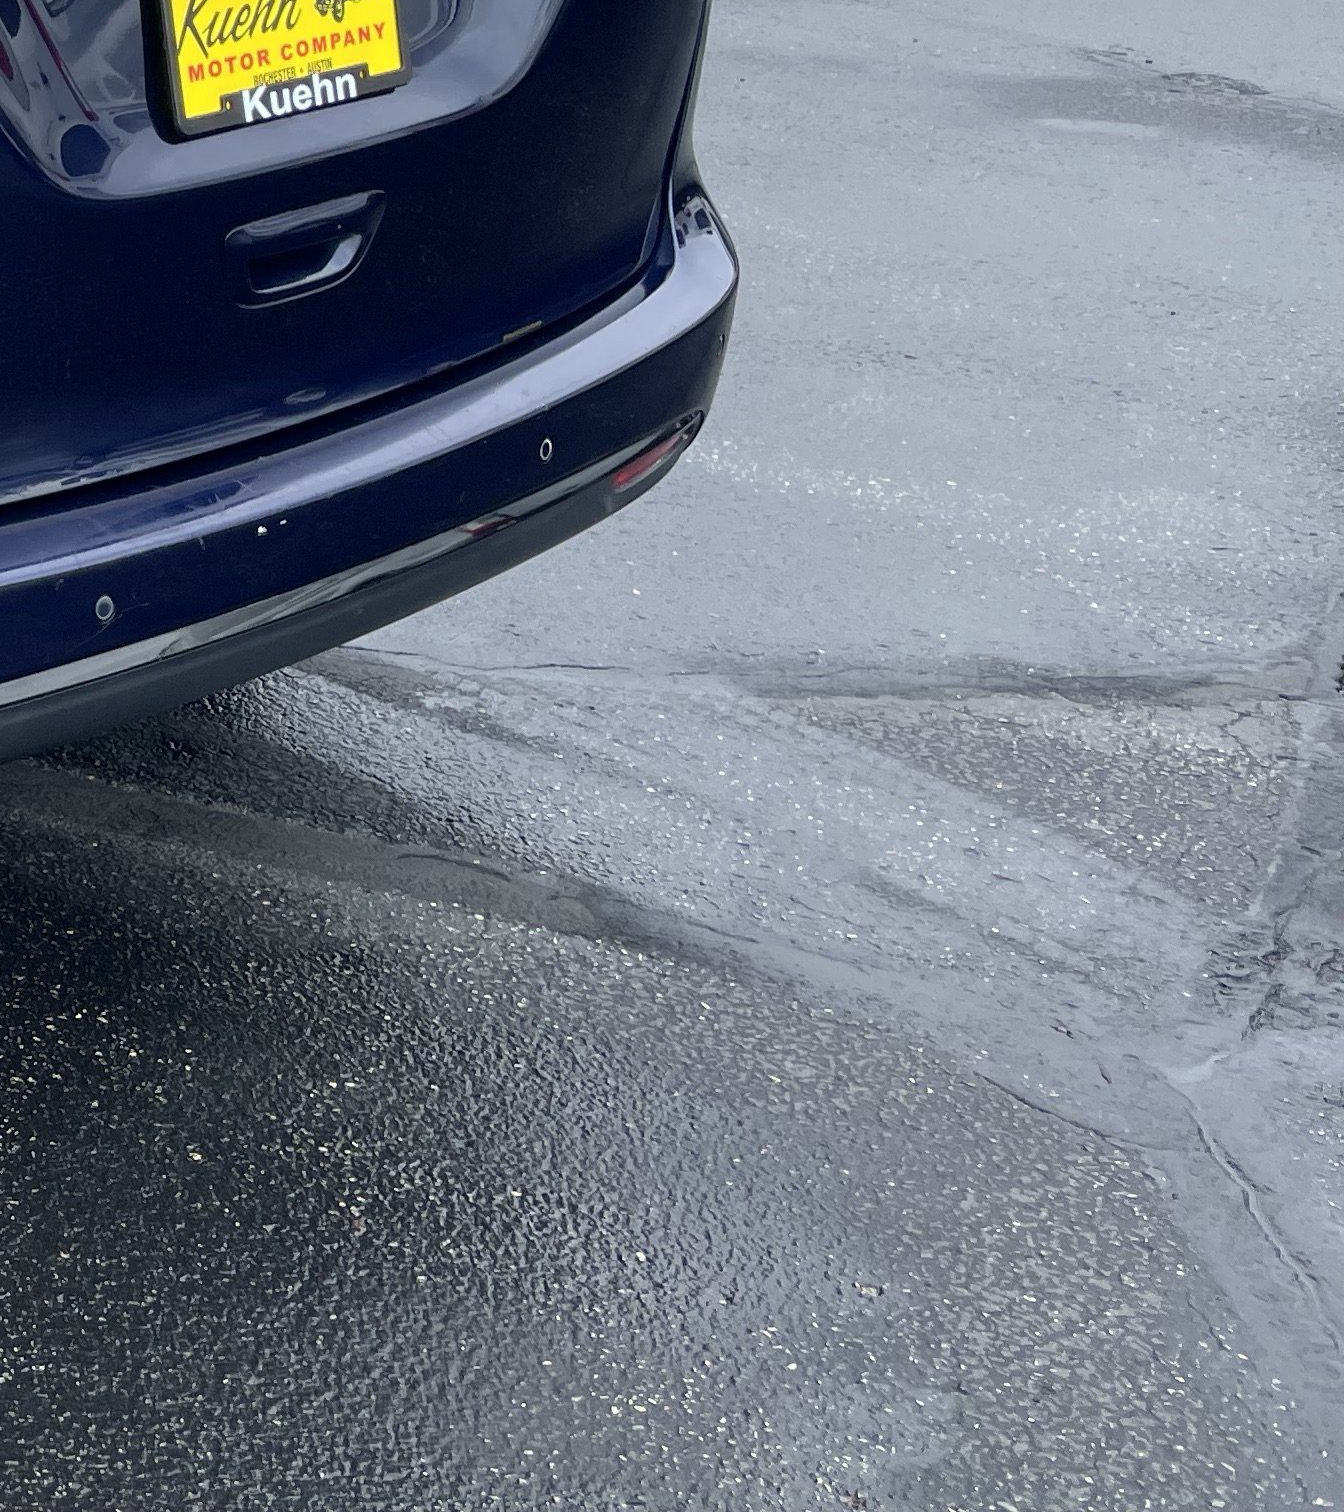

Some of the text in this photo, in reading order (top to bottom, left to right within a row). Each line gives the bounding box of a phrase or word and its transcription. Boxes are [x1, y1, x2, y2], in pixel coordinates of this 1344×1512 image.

[188, 22, 386, 83] MOTOR COMPANY
[242, 72, 357, 123] Kuehn
